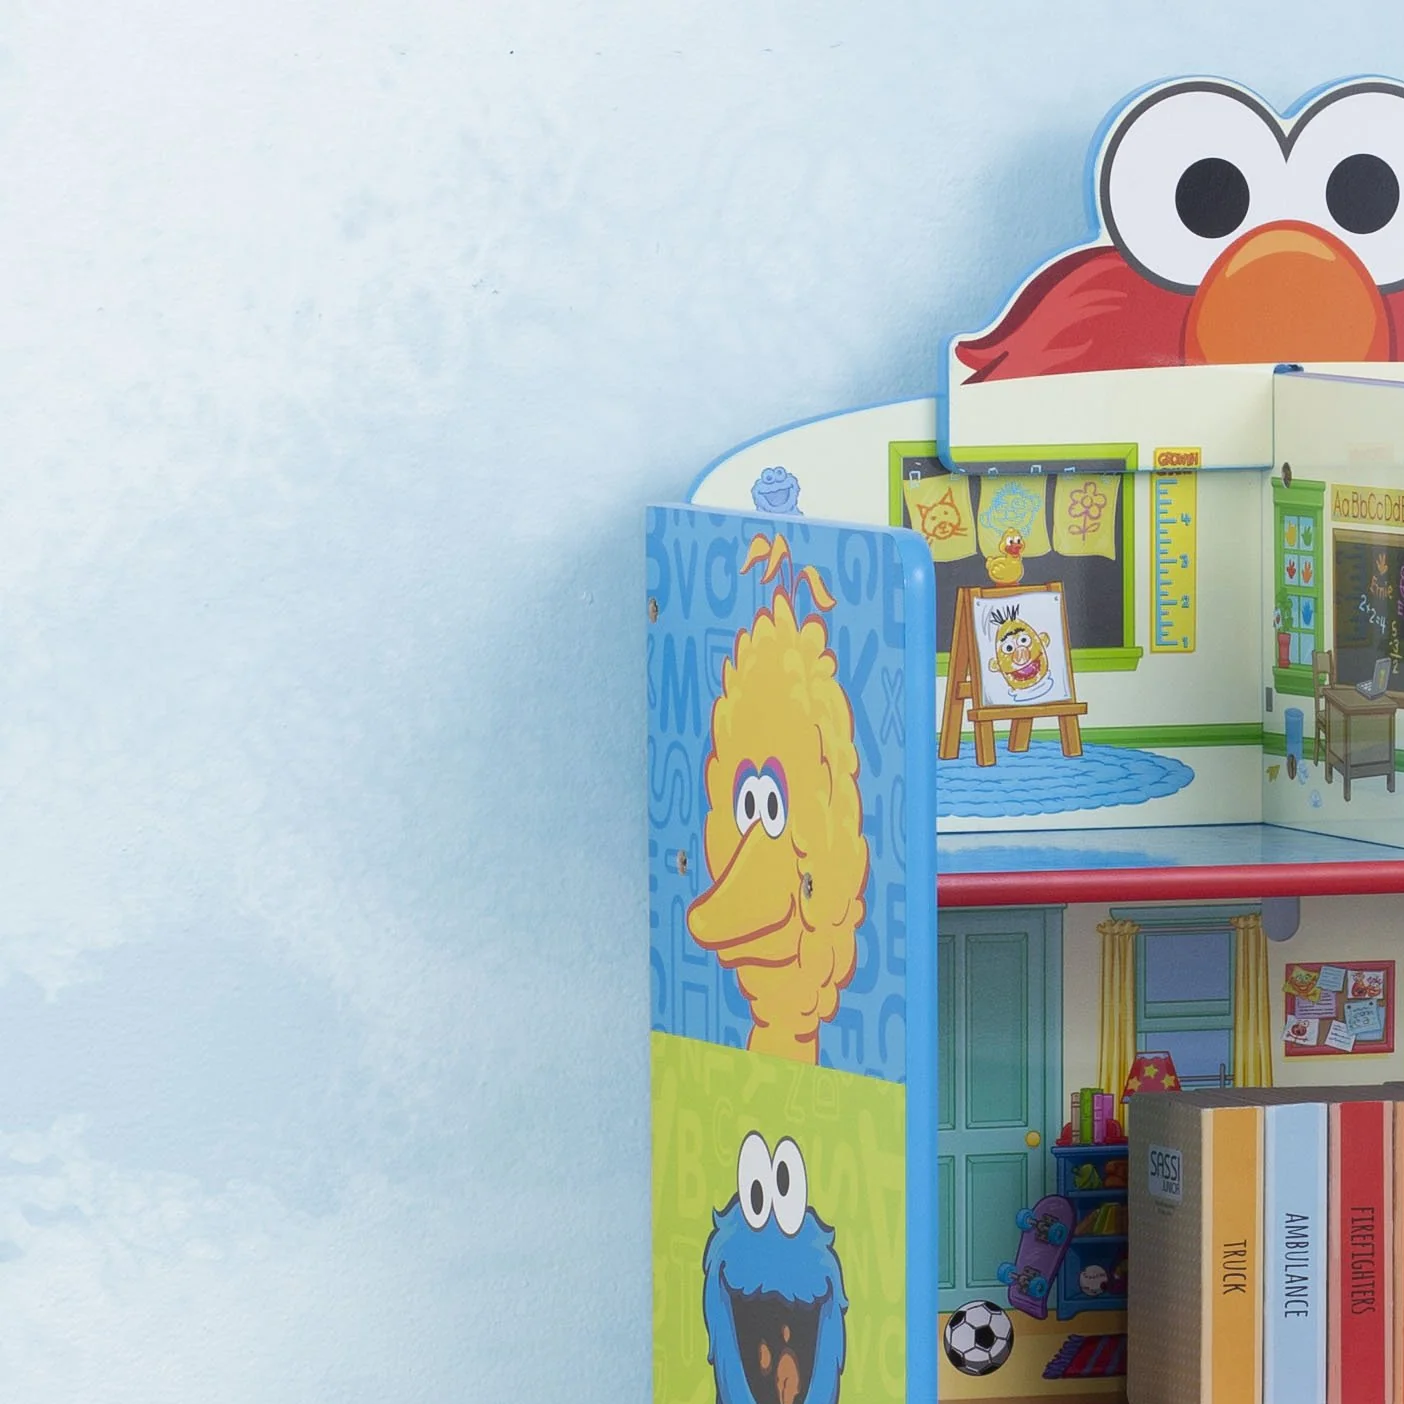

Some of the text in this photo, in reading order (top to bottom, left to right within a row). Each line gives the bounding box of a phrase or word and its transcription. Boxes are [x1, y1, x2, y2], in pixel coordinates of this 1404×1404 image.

[1150, 1150, 1180, 1184] SASSI
[1222, 1239, 1248, 1295] TRUCK
[1284, 1212, 1310, 1319] AMBULANCE
[1350, 1206, 1376, 1316] FIREFIGHTERS
